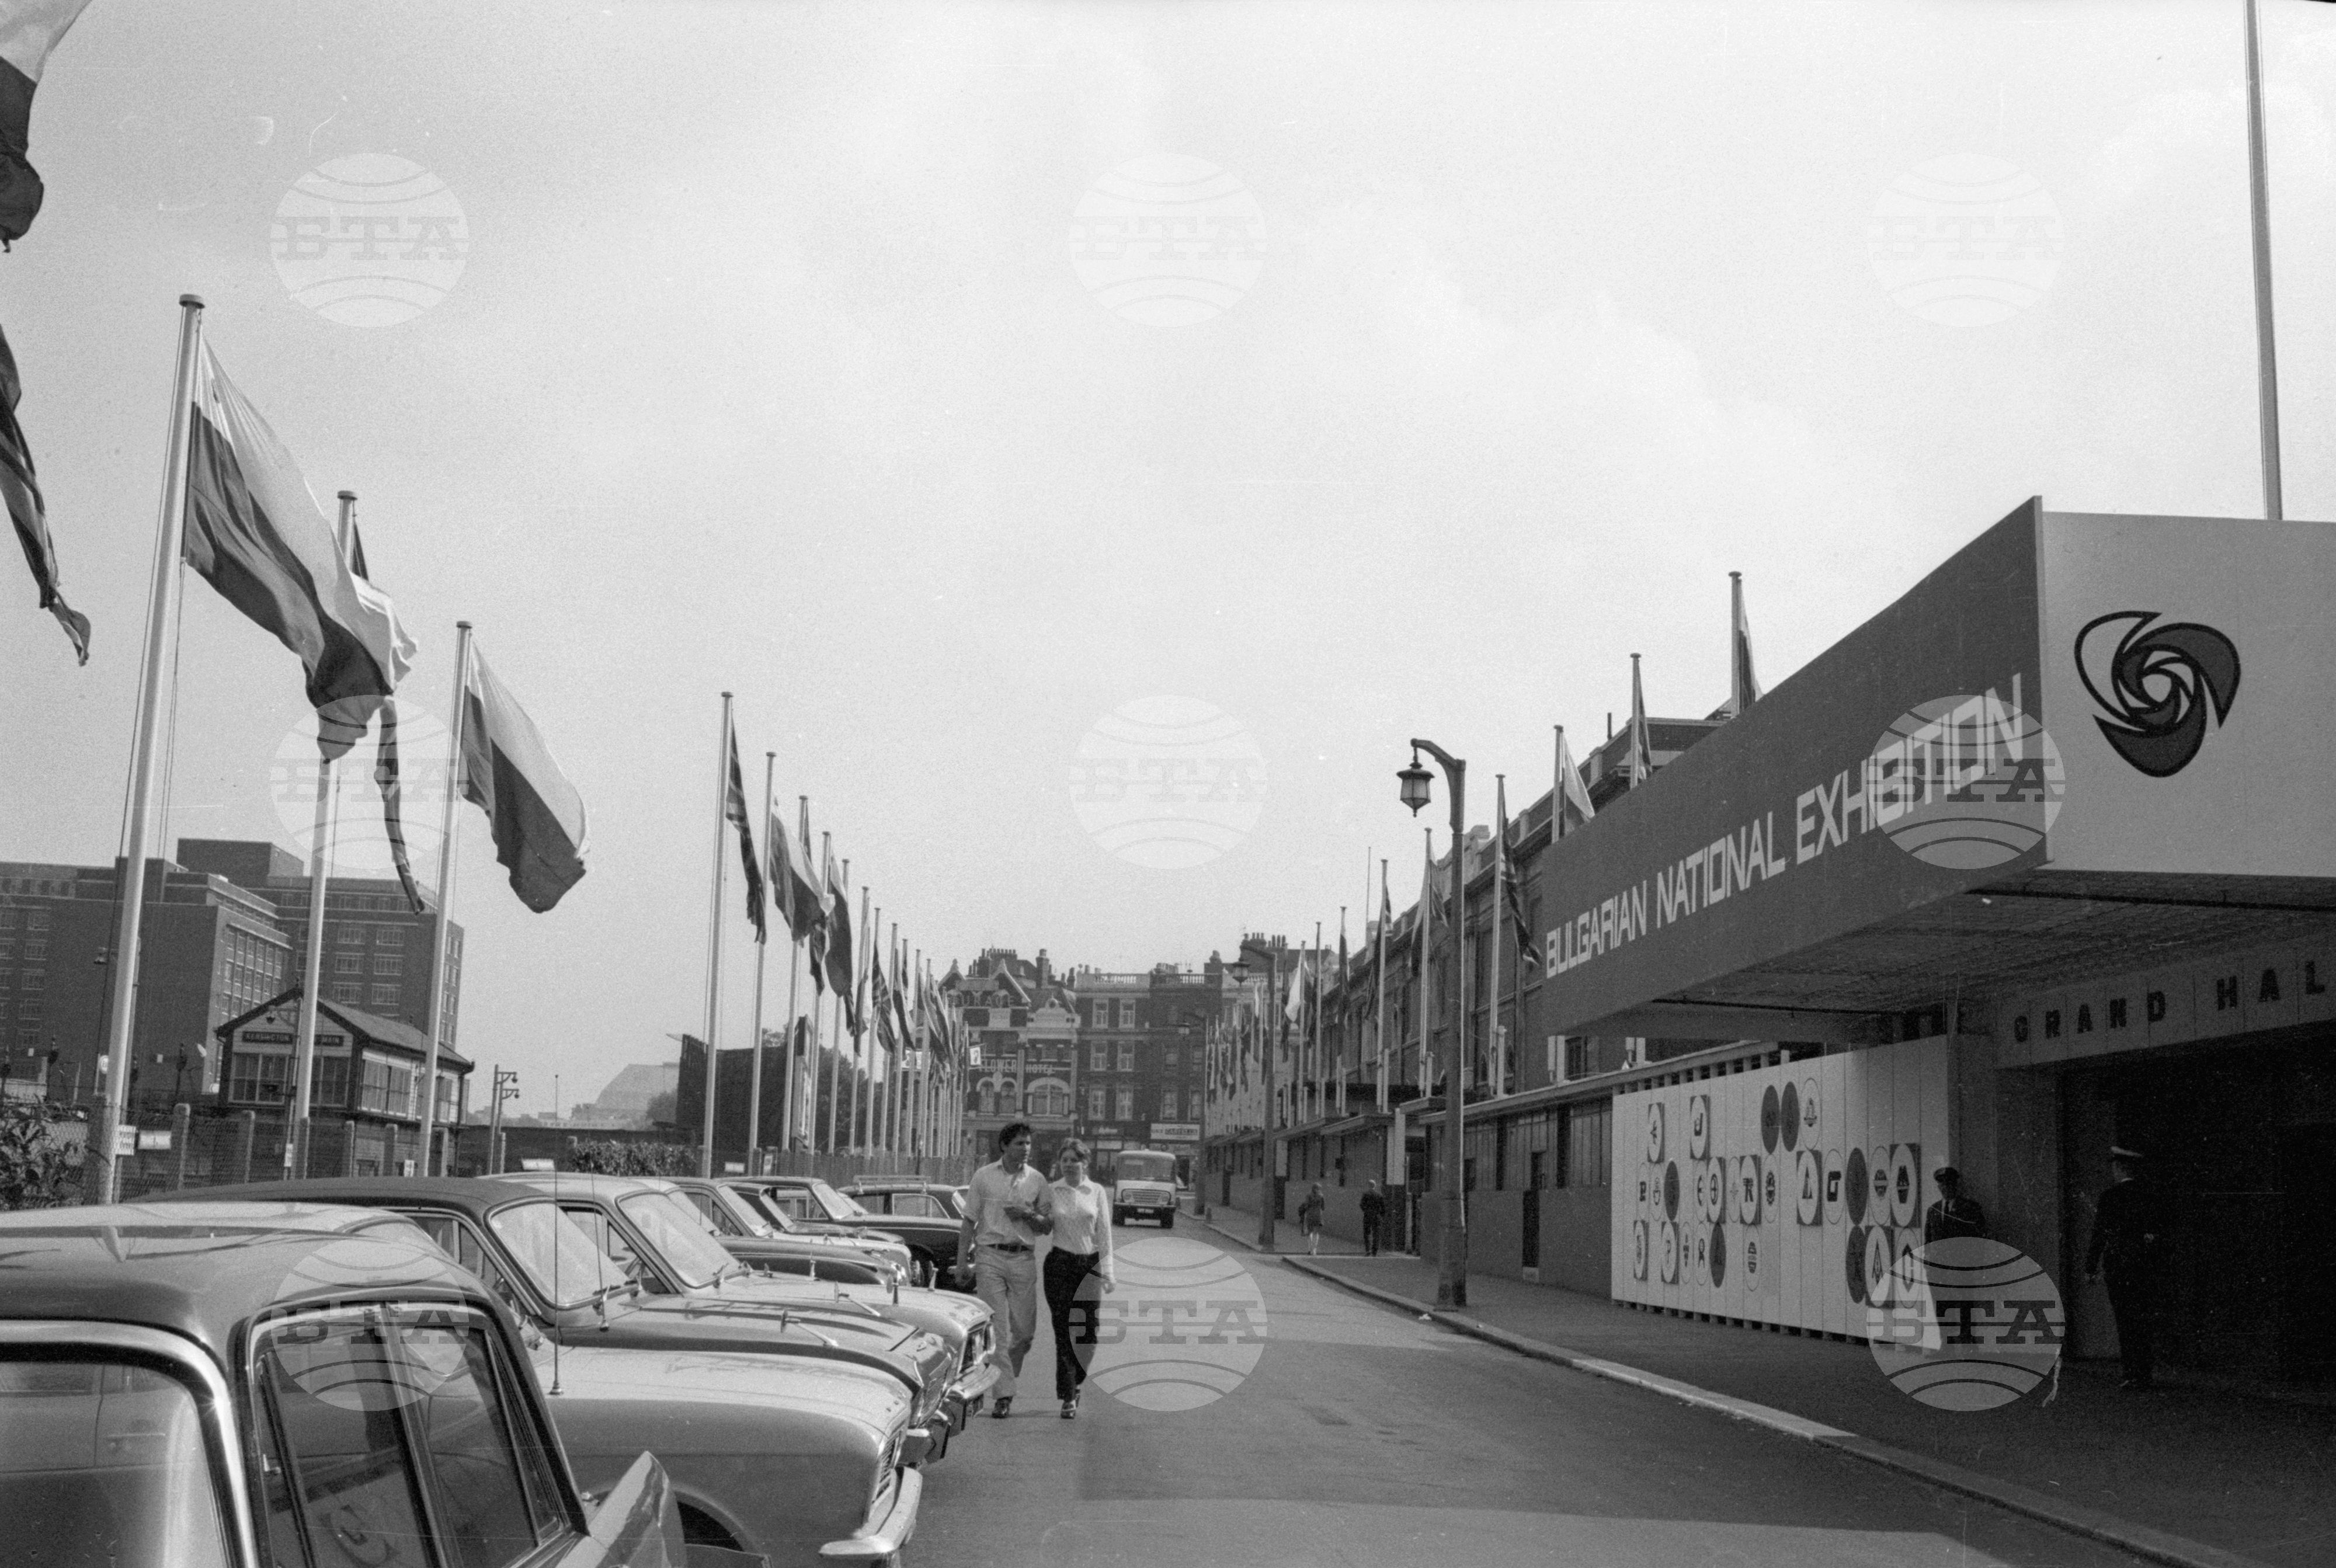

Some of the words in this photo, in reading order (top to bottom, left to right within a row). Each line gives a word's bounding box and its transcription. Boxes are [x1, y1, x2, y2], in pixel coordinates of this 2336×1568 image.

[1546, 881, 1647, 979] BULGARIAN
[1657, 811, 1786, 929] NATIONAL
[1797, 673, 2022, 865] EXHIBITION
[2014, 992, 2165, 1042] GRAND
[1026, 1063, 1055, 1073] HOTEL
